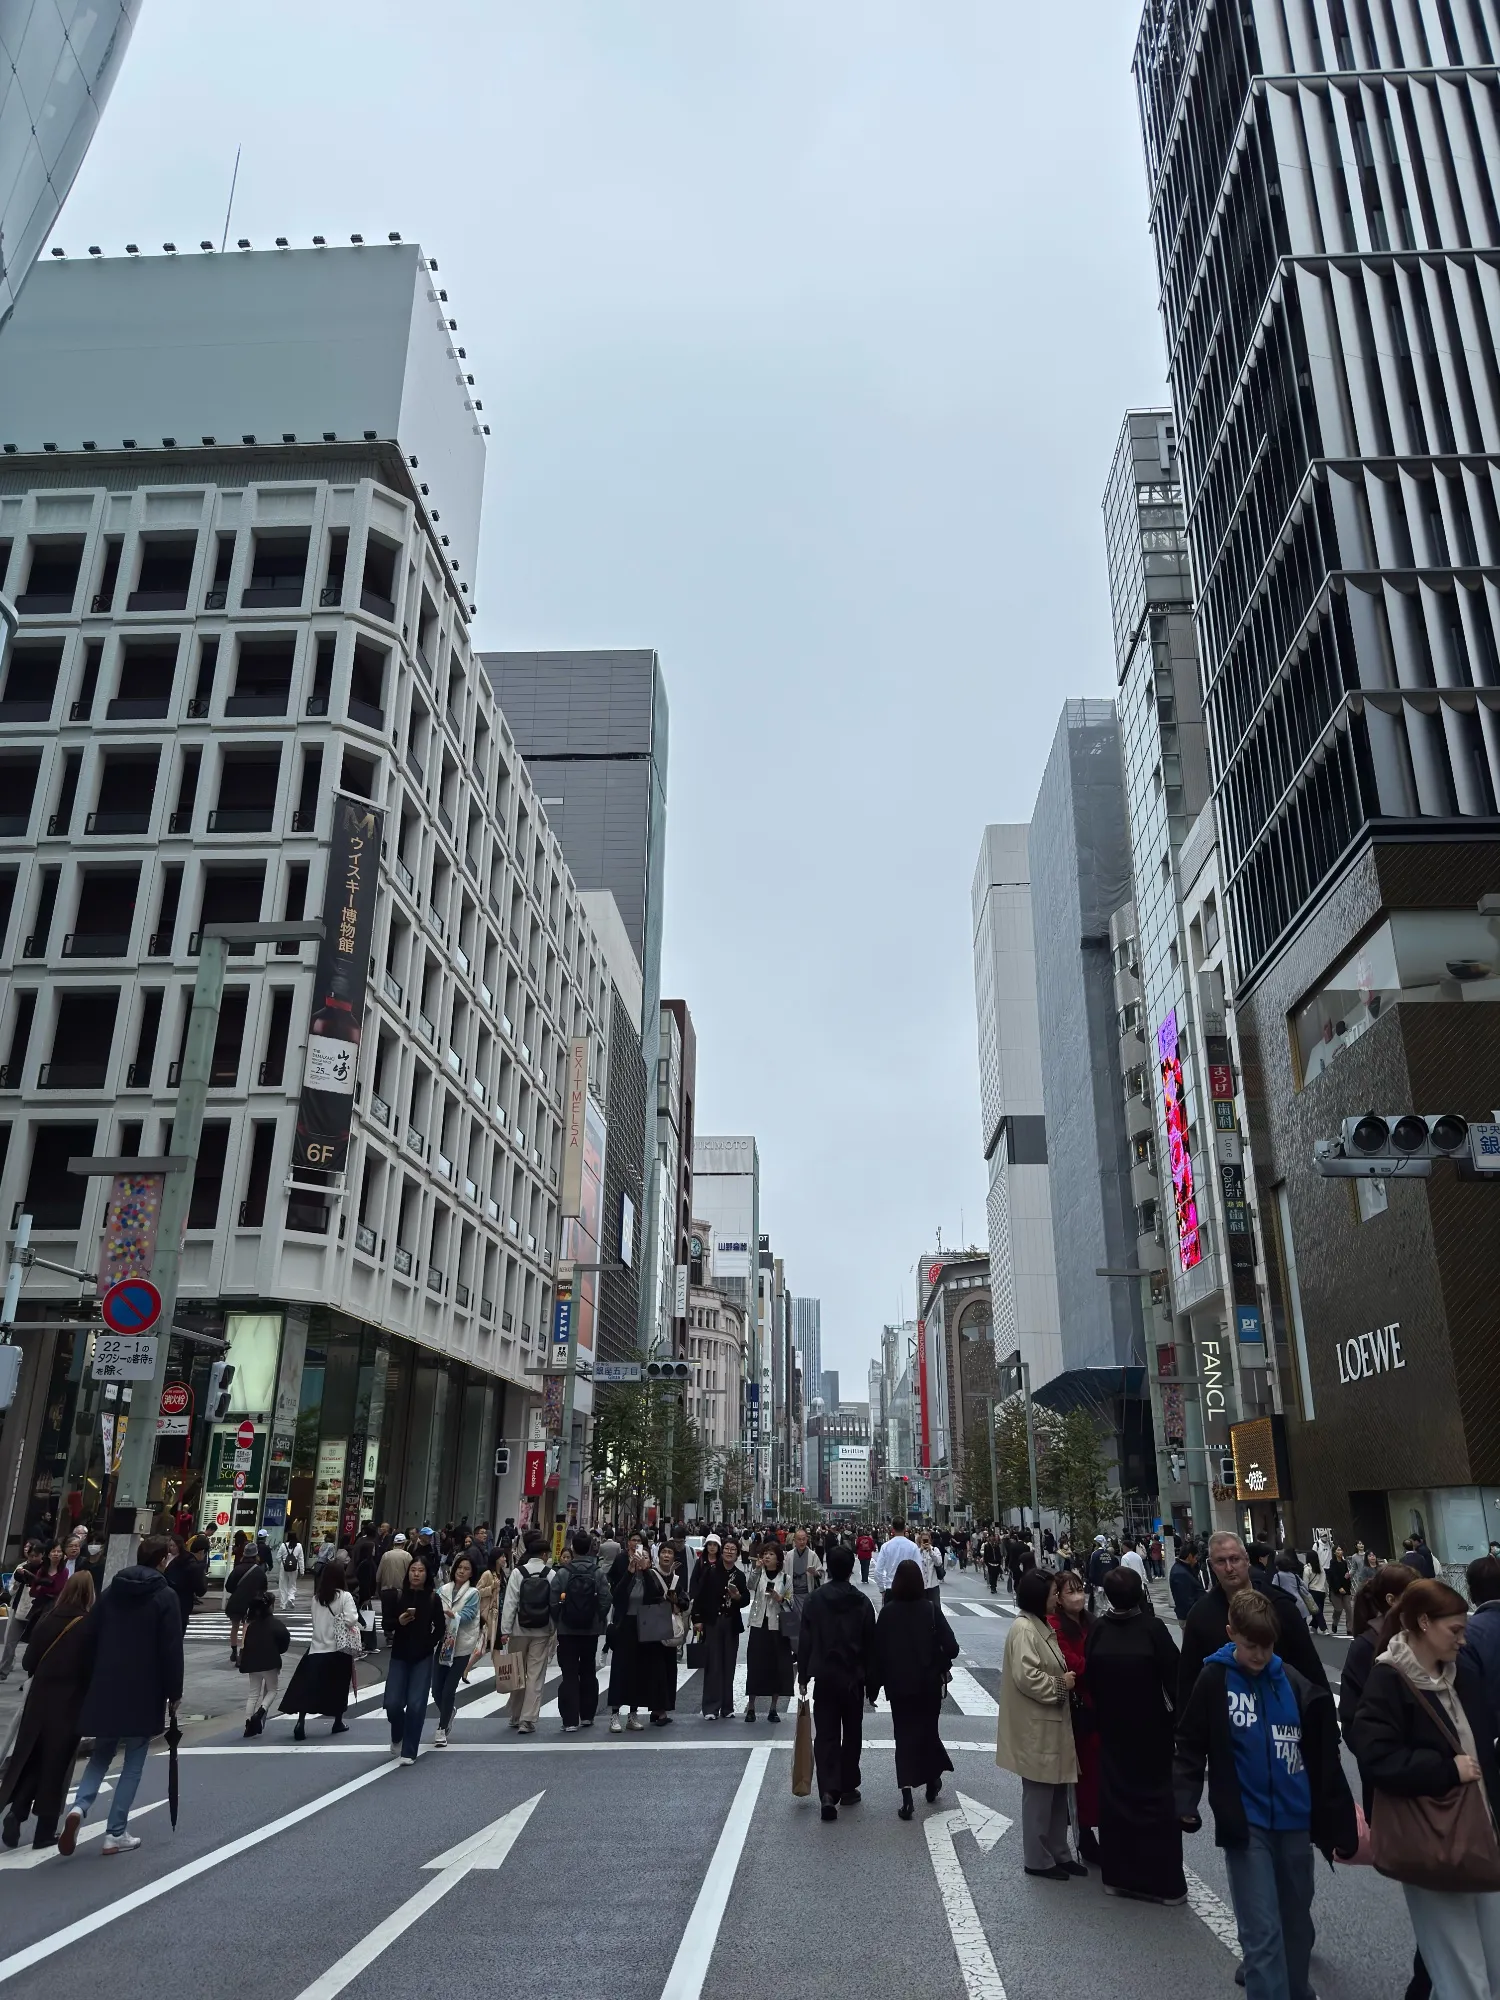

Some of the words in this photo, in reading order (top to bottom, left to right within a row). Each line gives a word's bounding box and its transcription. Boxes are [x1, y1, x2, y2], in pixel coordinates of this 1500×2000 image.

[338, 836, 364, 954] ウイスキー博物館
[1214, 1066, 1228, 1092] まつげ
[1217, 1102, 1231, 1128] 歯科
[306, 1143, 335, 1163] 6F
[1224, 1138, 1232, 1158] lore
[1480, 1135, 1500, 1155] 銀
[1222, 1166, 1235, 1197] Oasis
[677, 1271, 685, 1313] TASAKI
[560, 1305, 568, 1339] PLAZA
[97, 1353, 153, 1364] タクシーの客待ち
[1336, 1322, 1406, 1384] LOEWE
[95, 1364, 123, 1376] を除く
[596, 1366, 638, 1376] 銀座五丁目
[1201, 1341, 1226, 1422] FANCL
[164, 1395, 185, 1405] 消火栓
[498, 1664, 512, 1675] MUJI
